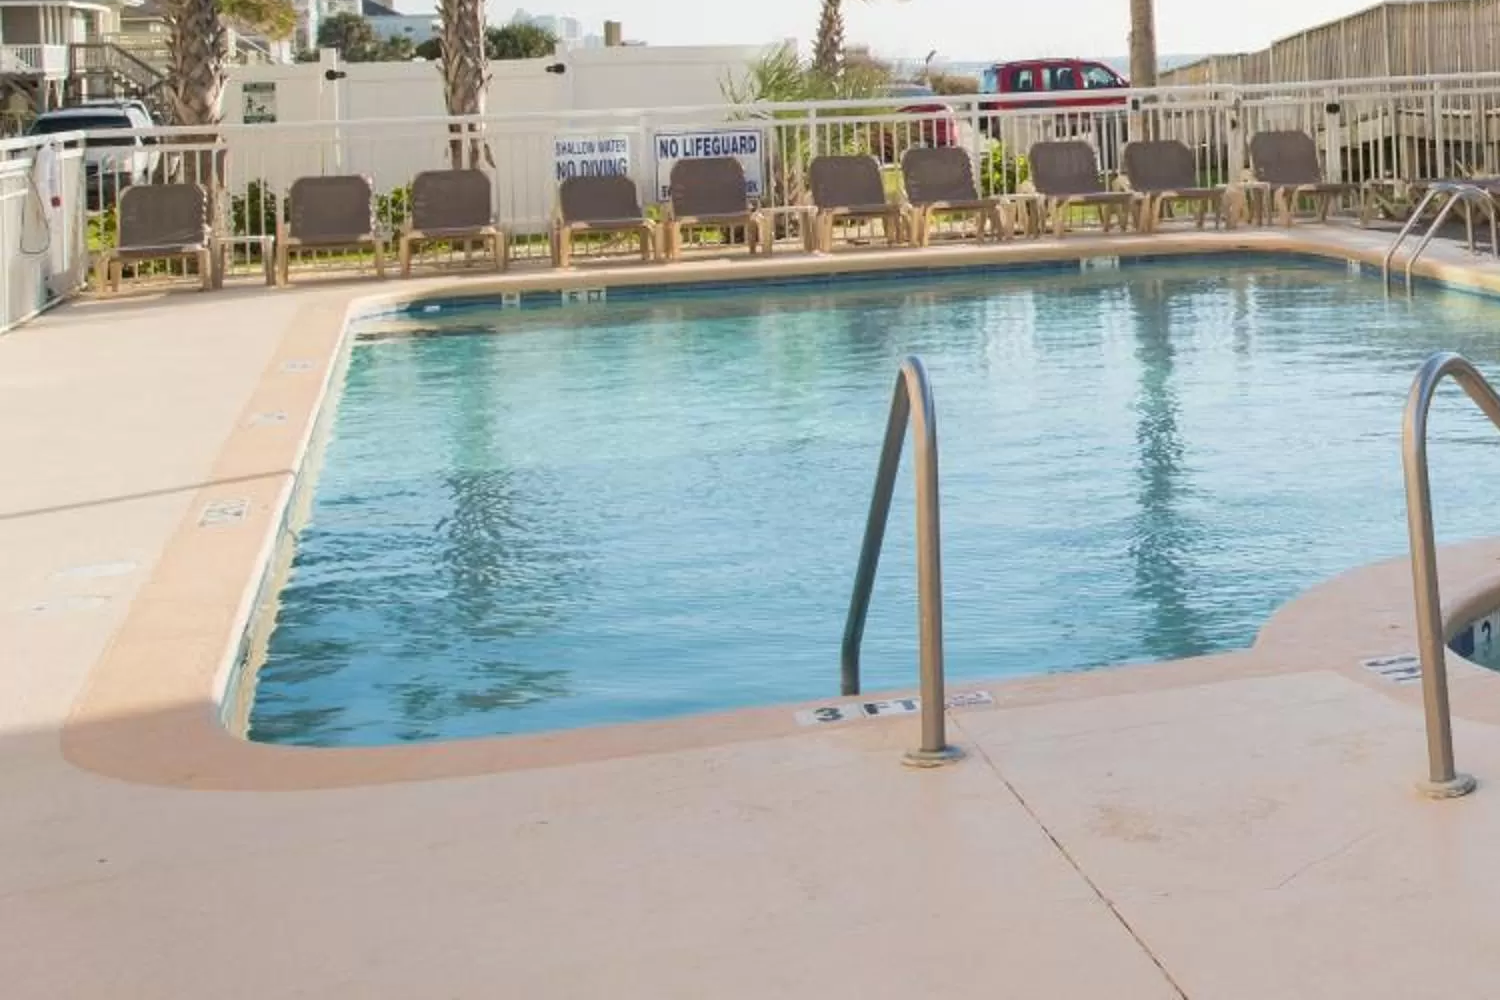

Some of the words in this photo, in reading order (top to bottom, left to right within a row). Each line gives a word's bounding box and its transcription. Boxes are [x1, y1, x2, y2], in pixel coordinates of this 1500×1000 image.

[555, 140, 595, 156] SHALLOW
[598, 139, 627, 153] WATER
[660, 138, 678, 158] NO
[683, 135, 757, 156] LIFEGUARD
[557, 160, 576, 180] NO
[581, 158, 627, 177] DIVING
[814, 707, 844, 722] 3
[863, 699, 918, 715] FT
